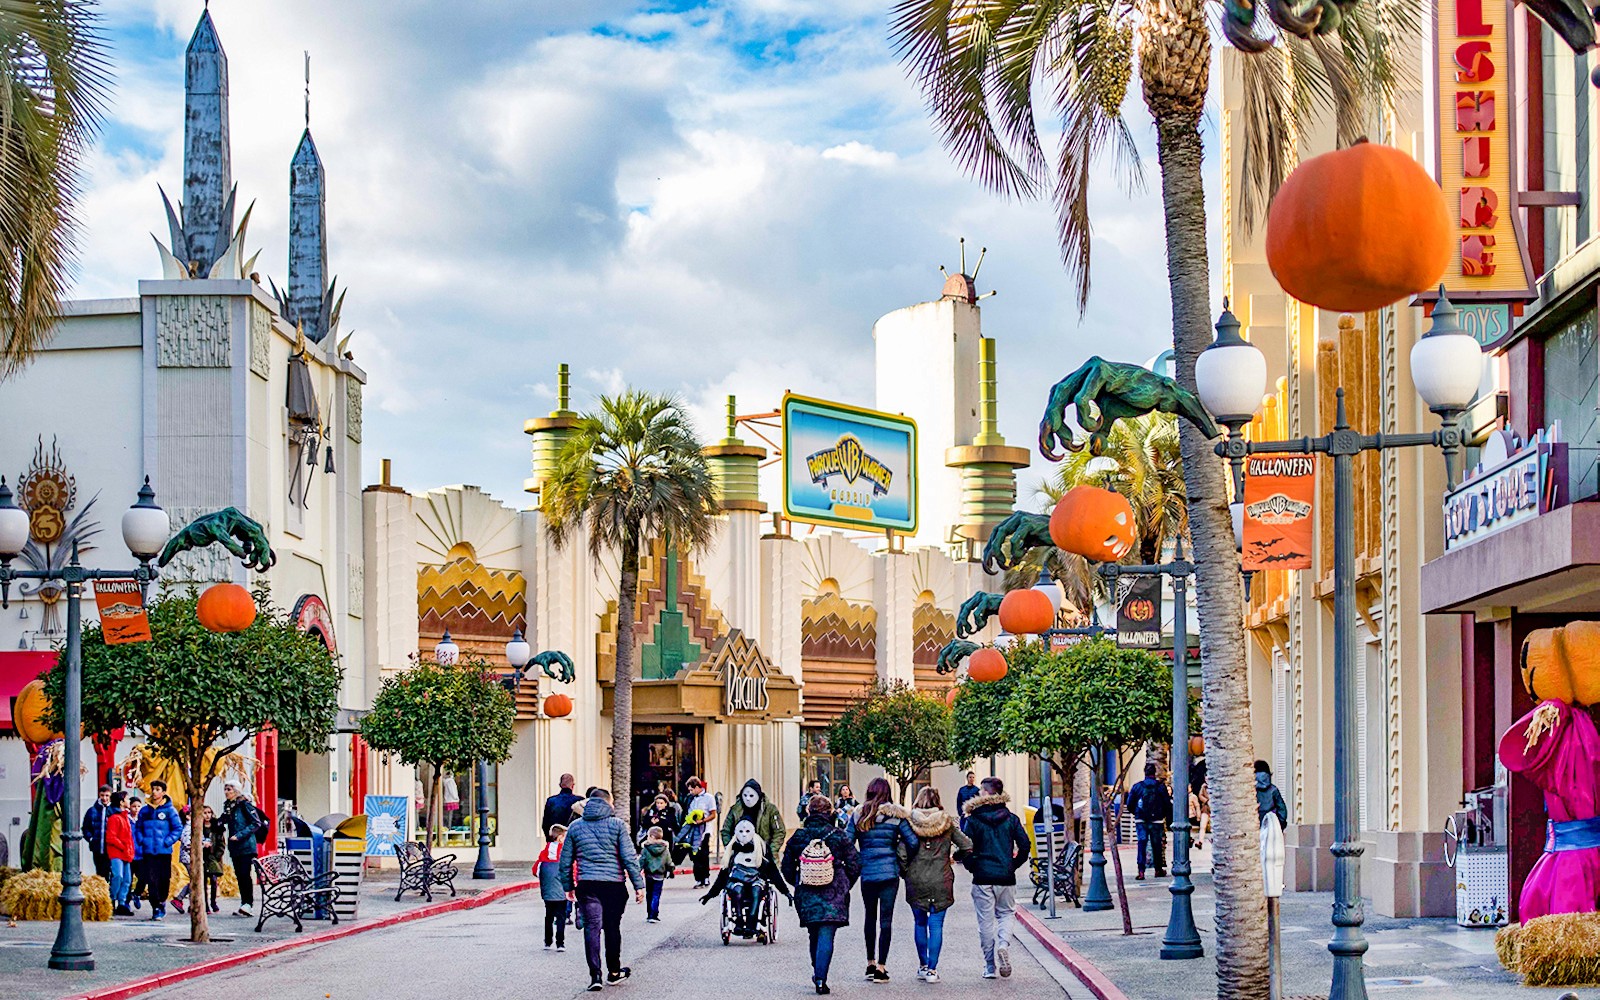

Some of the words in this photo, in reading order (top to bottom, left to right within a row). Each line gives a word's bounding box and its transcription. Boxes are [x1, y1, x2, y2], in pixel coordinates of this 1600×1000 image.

[808, 451, 842, 480] PARQUE
[860, 456, 893, 490] WARNER
[1249, 457, 1313, 477] HALLOWEEN
[1443, 492, 1478, 540] TOY
[1478, 463, 1536, 527] STORE
[95, 582, 139, 593] HALLOWEEN
[1118, 631, 1160, 644] HALLOWEEN
